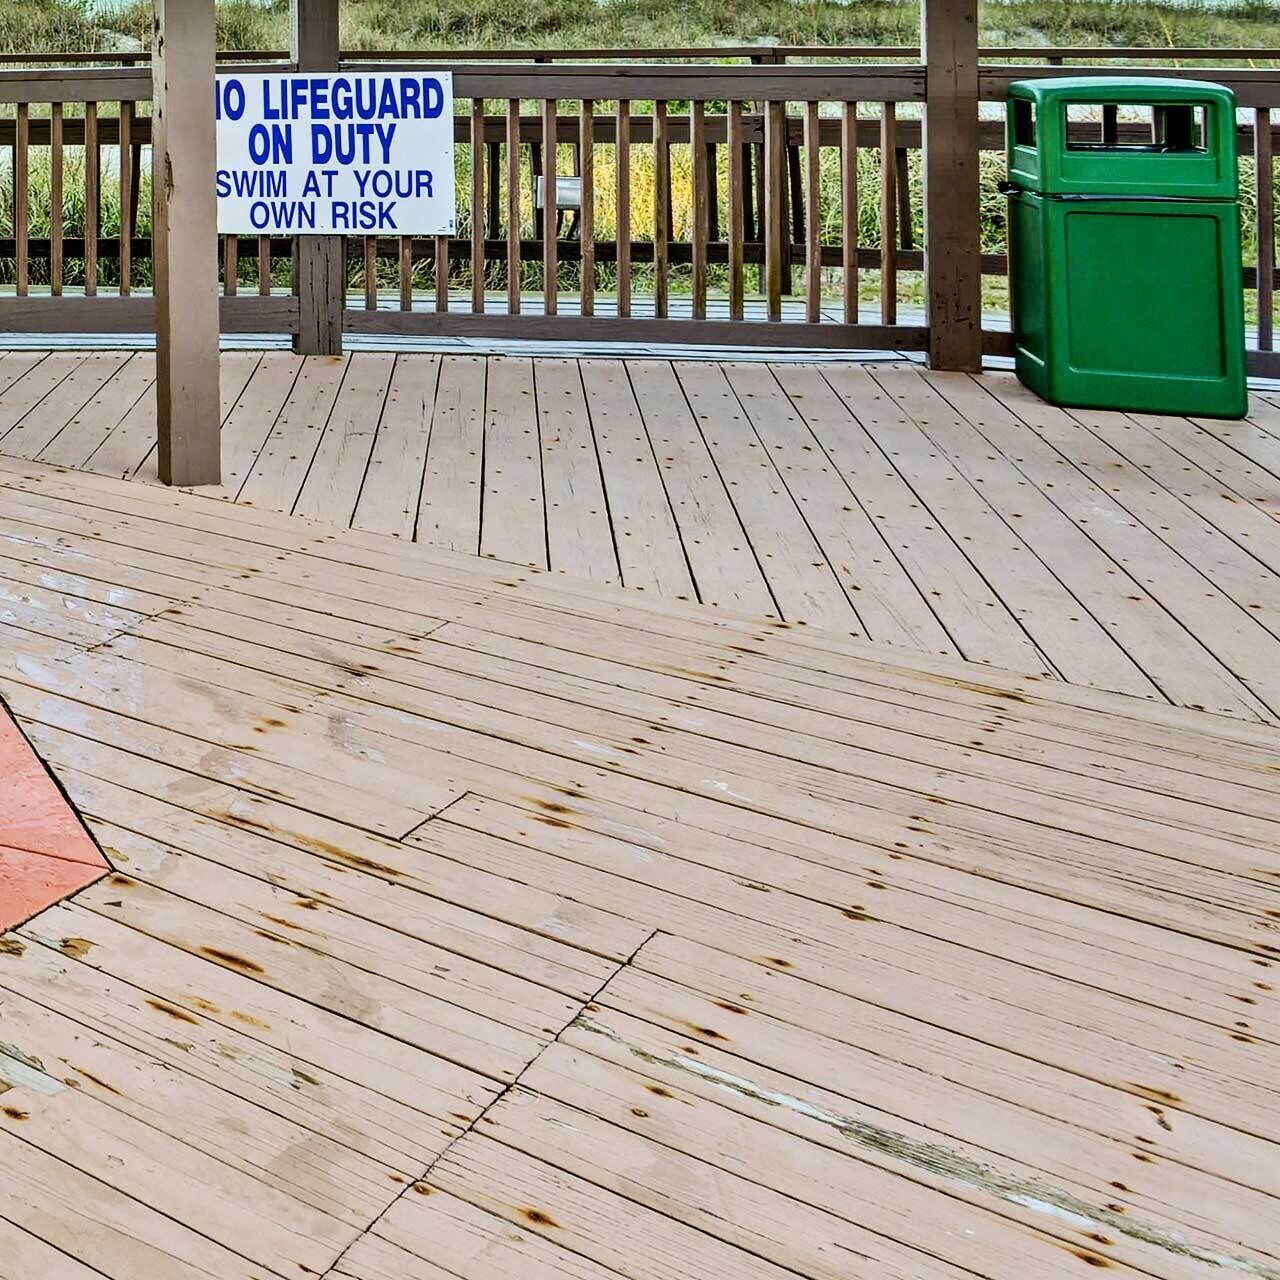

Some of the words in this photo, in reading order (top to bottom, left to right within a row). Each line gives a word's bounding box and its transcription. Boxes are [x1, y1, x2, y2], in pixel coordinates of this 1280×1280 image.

[216, 79, 245, 121] O
[263, 77, 444, 120] LIFEGUARD
[249, 124, 292, 165] ON
[312, 123, 397, 165] DUTY
[216, 170, 287, 198] SWIM
[303, 170, 338, 197] AT
[355, 170, 433, 198] YOUR
[250, 201, 316, 229] OWN
[332, 201, 398, 229] RISK
